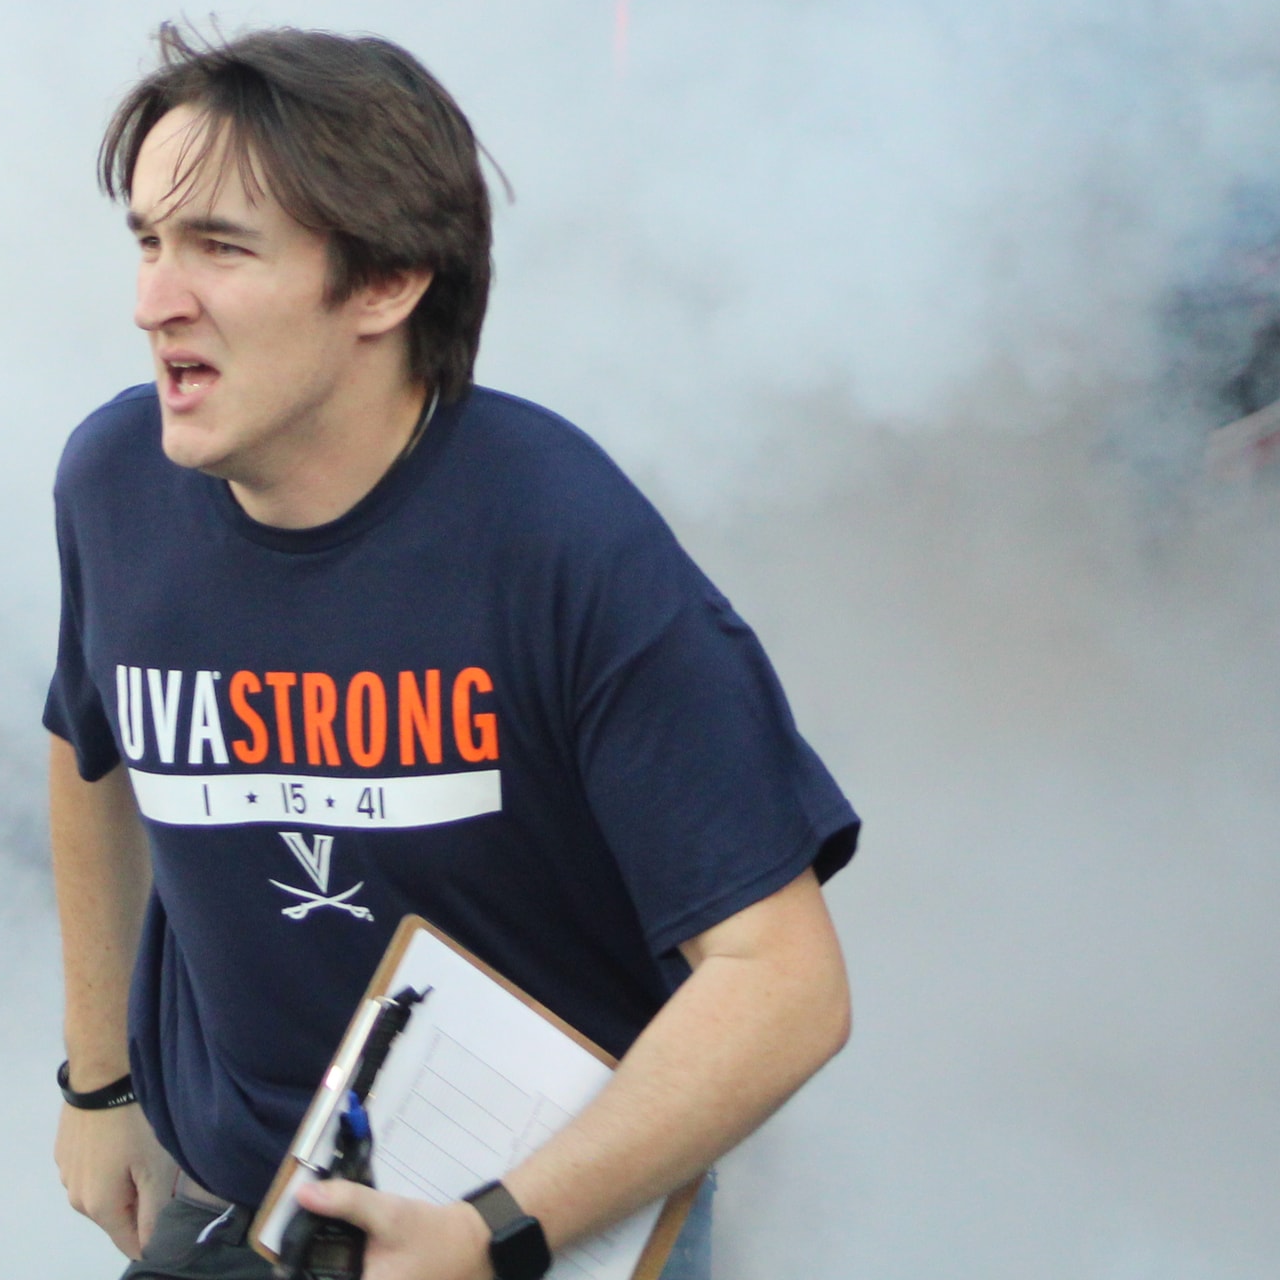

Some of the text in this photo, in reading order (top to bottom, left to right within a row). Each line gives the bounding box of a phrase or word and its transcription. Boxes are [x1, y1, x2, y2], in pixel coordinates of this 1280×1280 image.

[201, 782, 385, 819] 1 15 41
